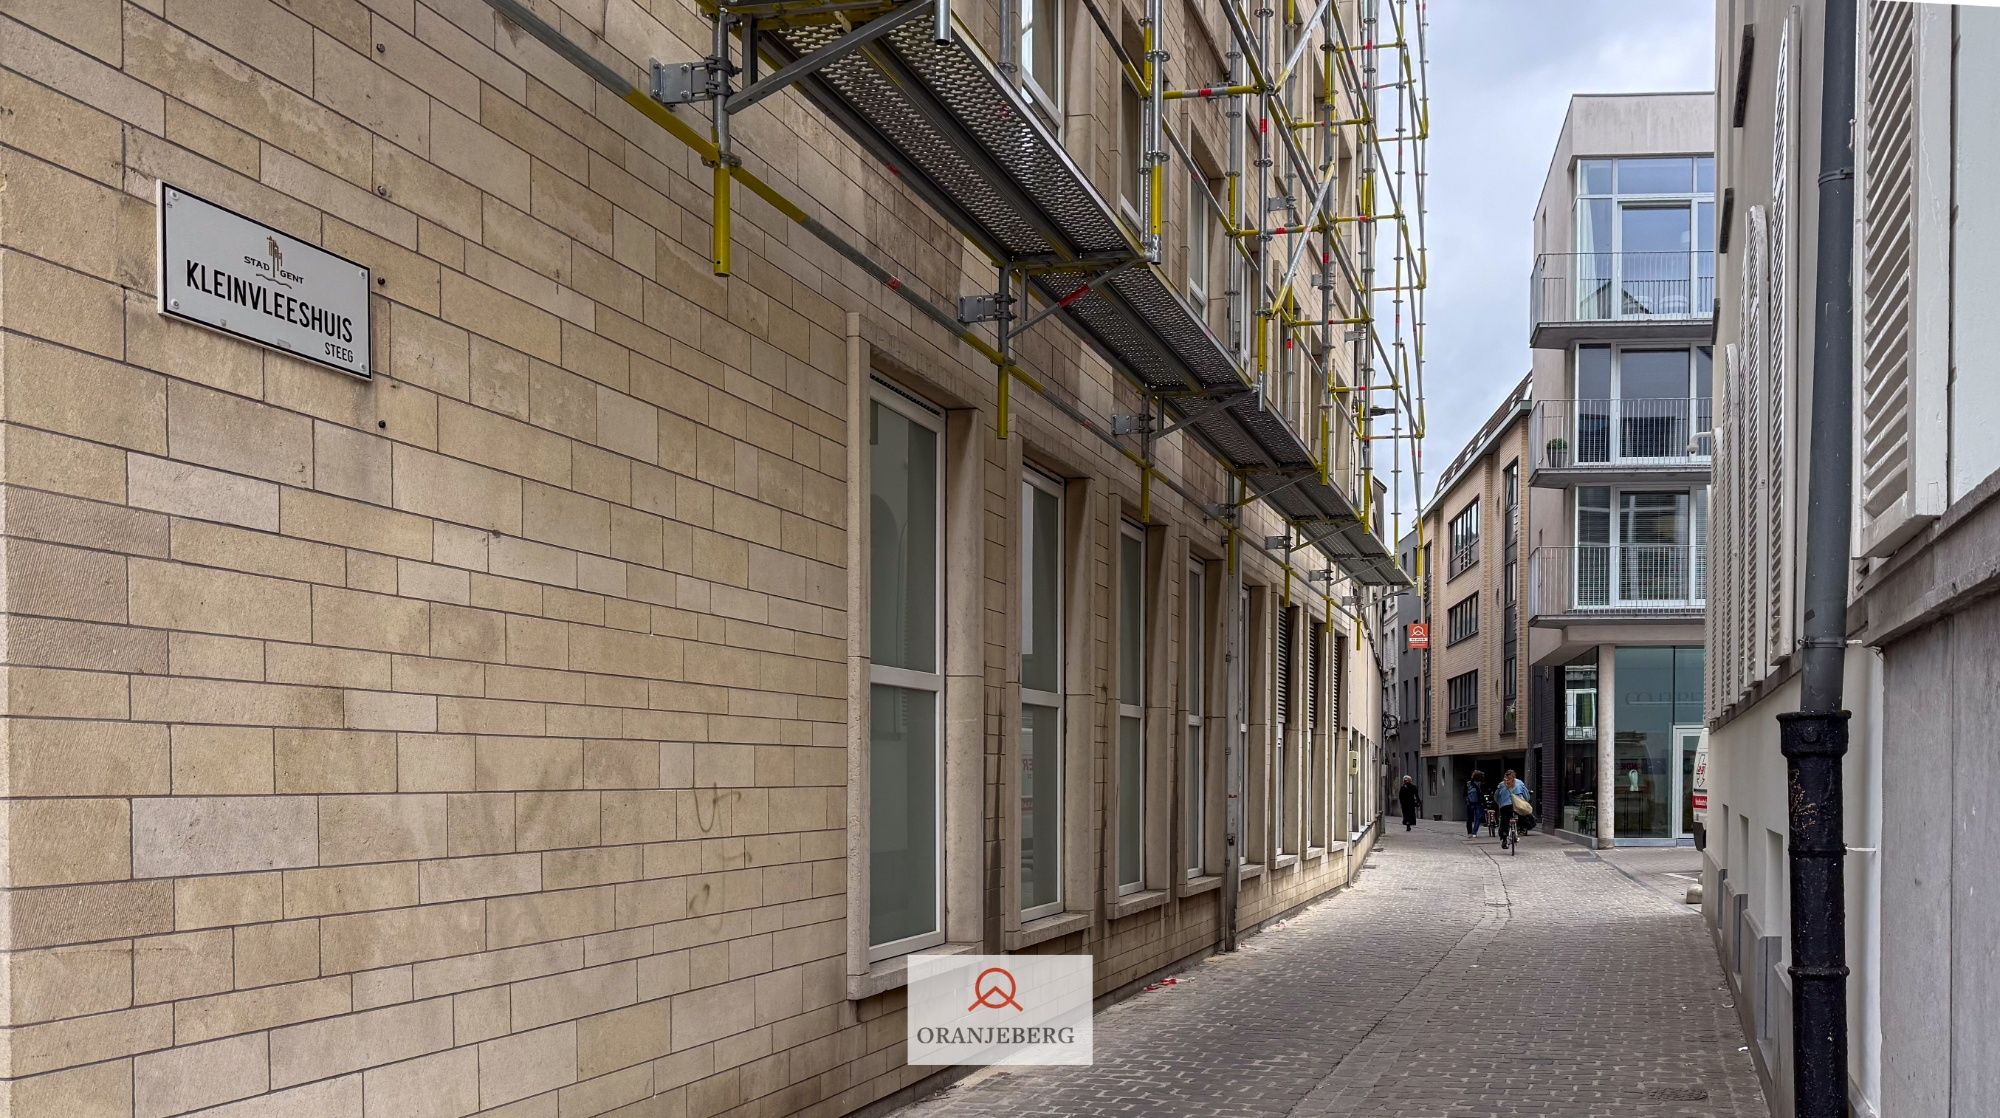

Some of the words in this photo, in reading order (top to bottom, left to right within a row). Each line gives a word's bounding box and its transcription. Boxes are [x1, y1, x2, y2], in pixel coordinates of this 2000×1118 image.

[243, 255, 270, 271] STAD
[279, 269, 304, 285] GENT
[186, 259, 353, 343] KLEINVLEESHUIS
[324, 342, 354, 363] STEEG
